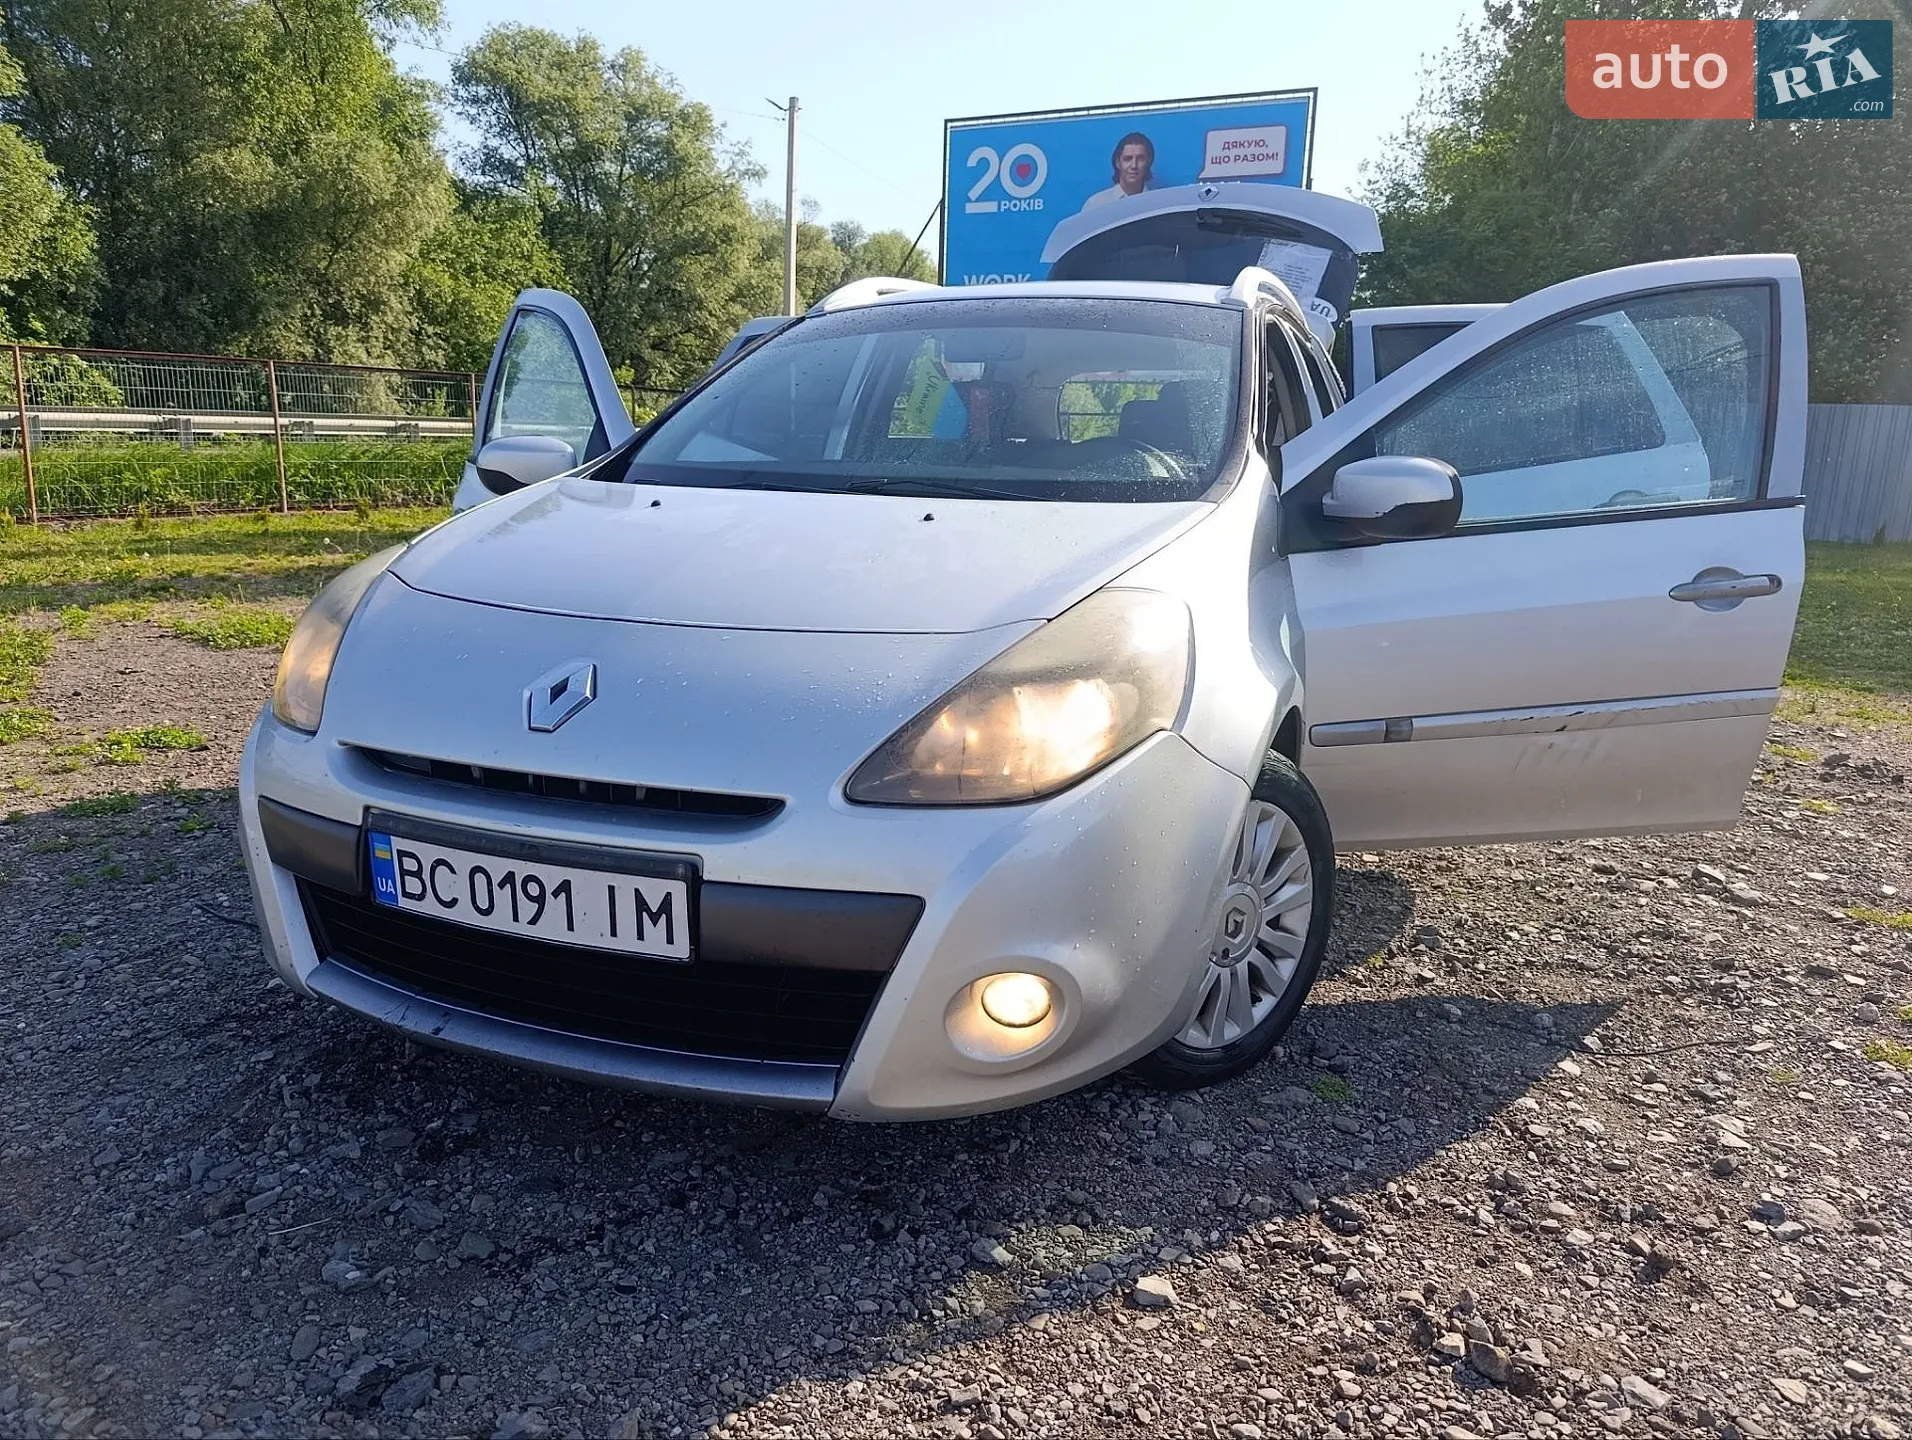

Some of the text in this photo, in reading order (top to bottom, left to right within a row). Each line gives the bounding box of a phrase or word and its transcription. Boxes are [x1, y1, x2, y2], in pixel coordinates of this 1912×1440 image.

[1222, 139, 1269, 151] ДЯКУЮ,
[1211, 152, 1279, 165] ЩО РАЗОМ!
[966, 143, 1048, 213] 20
[1000, 199, 1044, 212] РОКІВ
[1310, 300, 1331, 317] UA
[378, 875, 396, 895] UA
[396, 848, 459, 909] BC
[468, 865, 575, 933] 0191
